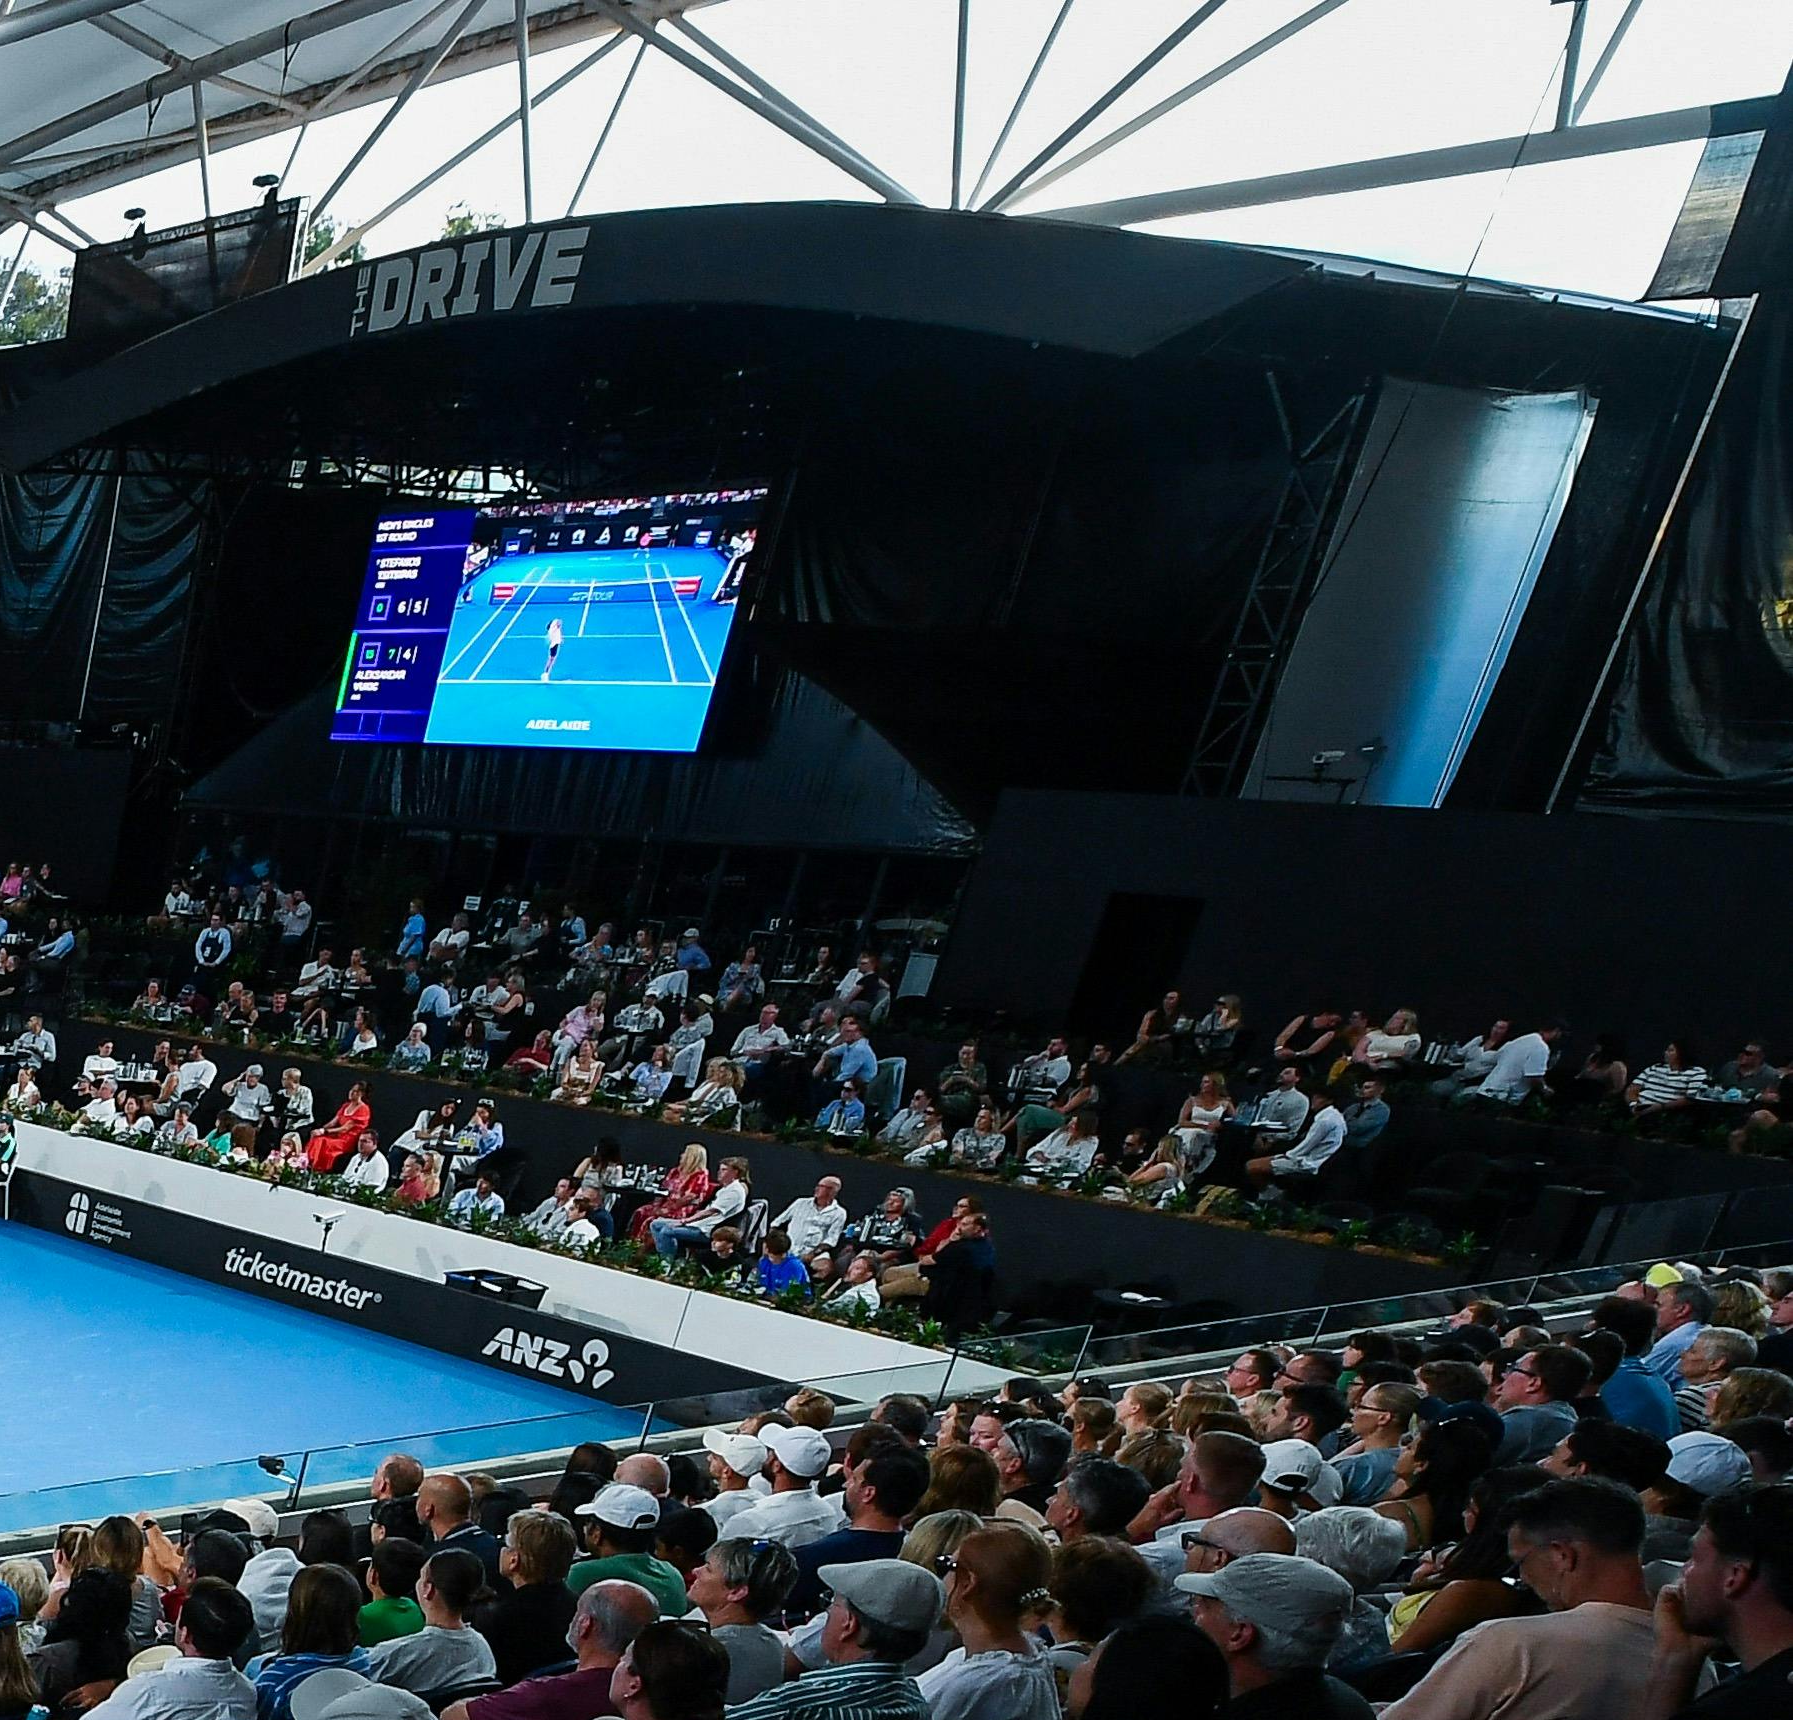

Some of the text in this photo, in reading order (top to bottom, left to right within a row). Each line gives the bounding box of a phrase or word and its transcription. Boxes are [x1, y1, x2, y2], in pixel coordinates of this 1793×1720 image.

[350, 226, 591, 338] THE DRIVE
[397, 601, 407, 613] 6
[388, 648, 396, 660] 7
[402, 648, 411, 660] 4
[525, 719, 591, 731] ADELAIDE
[481, 1326, 572, 1379] ANZ
